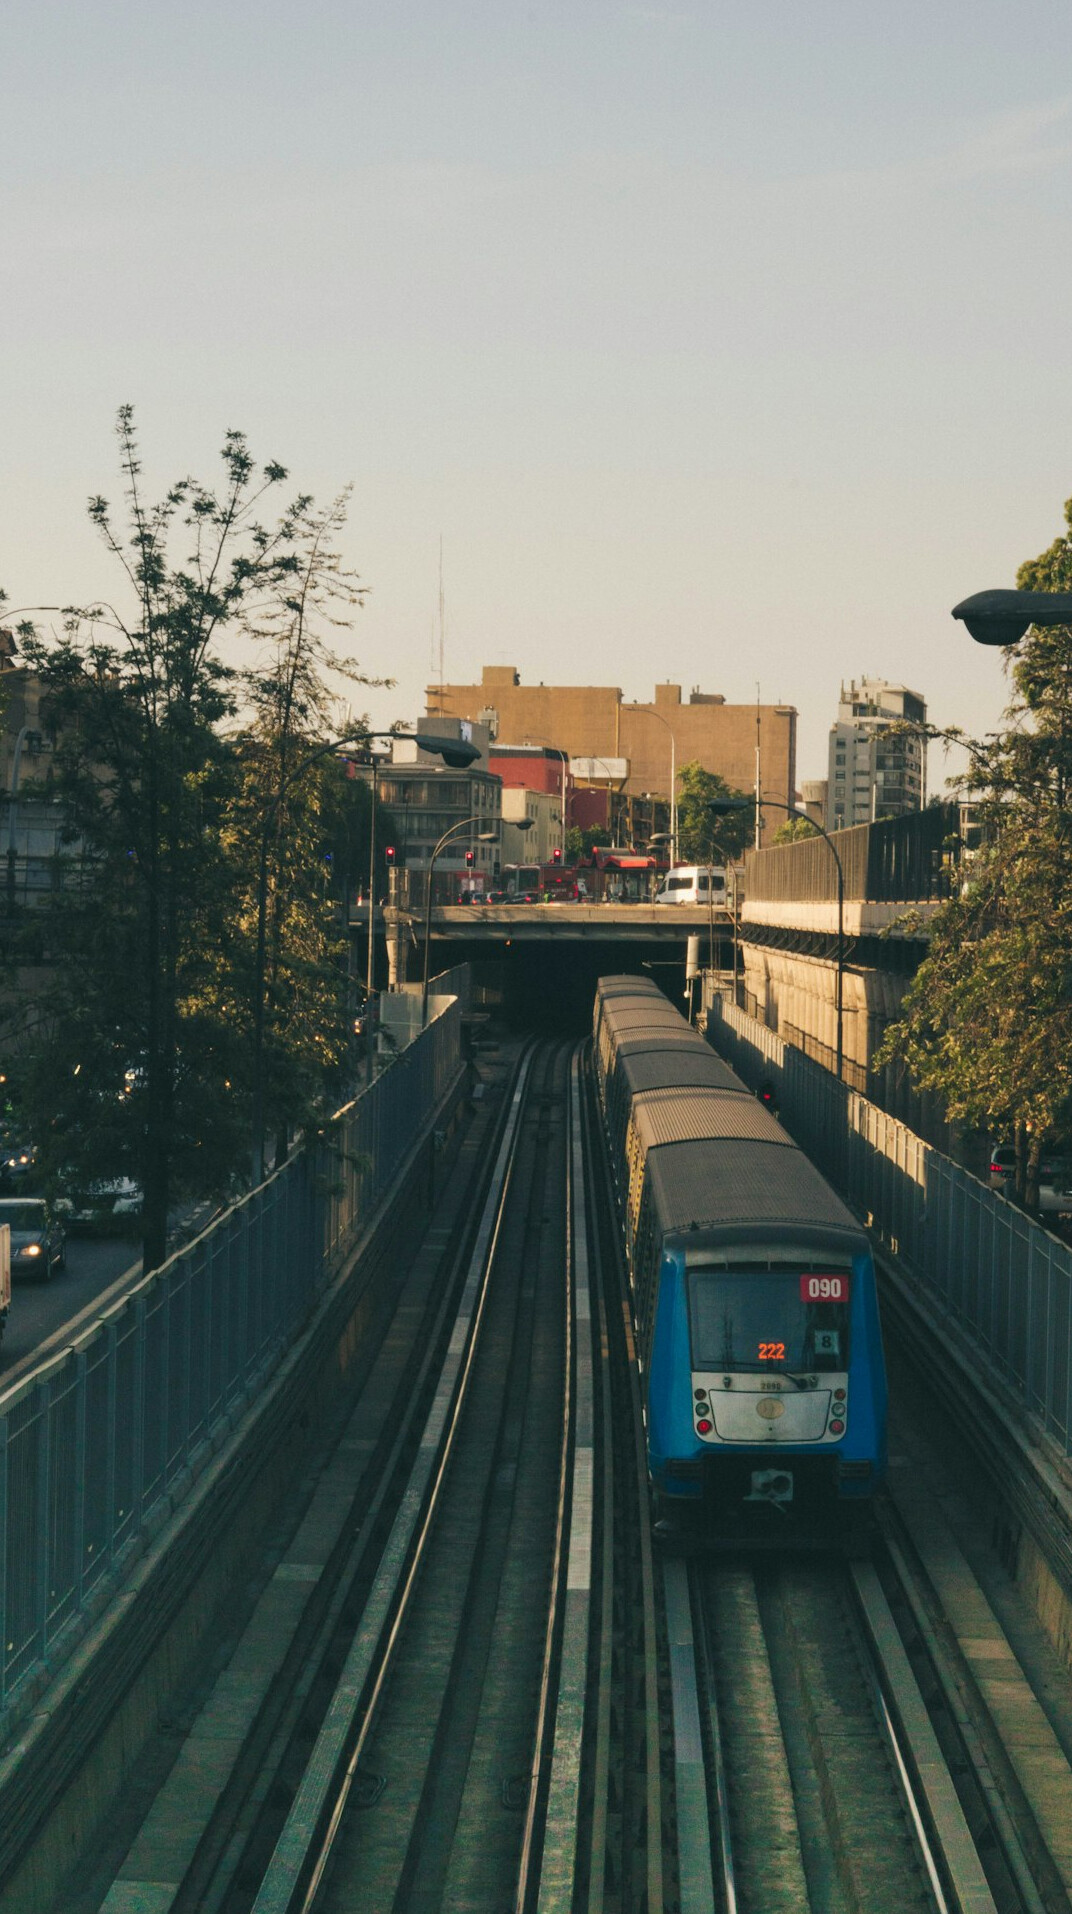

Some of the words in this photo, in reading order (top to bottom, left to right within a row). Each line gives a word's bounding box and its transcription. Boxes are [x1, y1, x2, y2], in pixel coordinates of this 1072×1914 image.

[809, 1278, 841, 1298] 090
[822, 1335, 831, 1348] 8
[758, 1343, 785, 1359] 222
